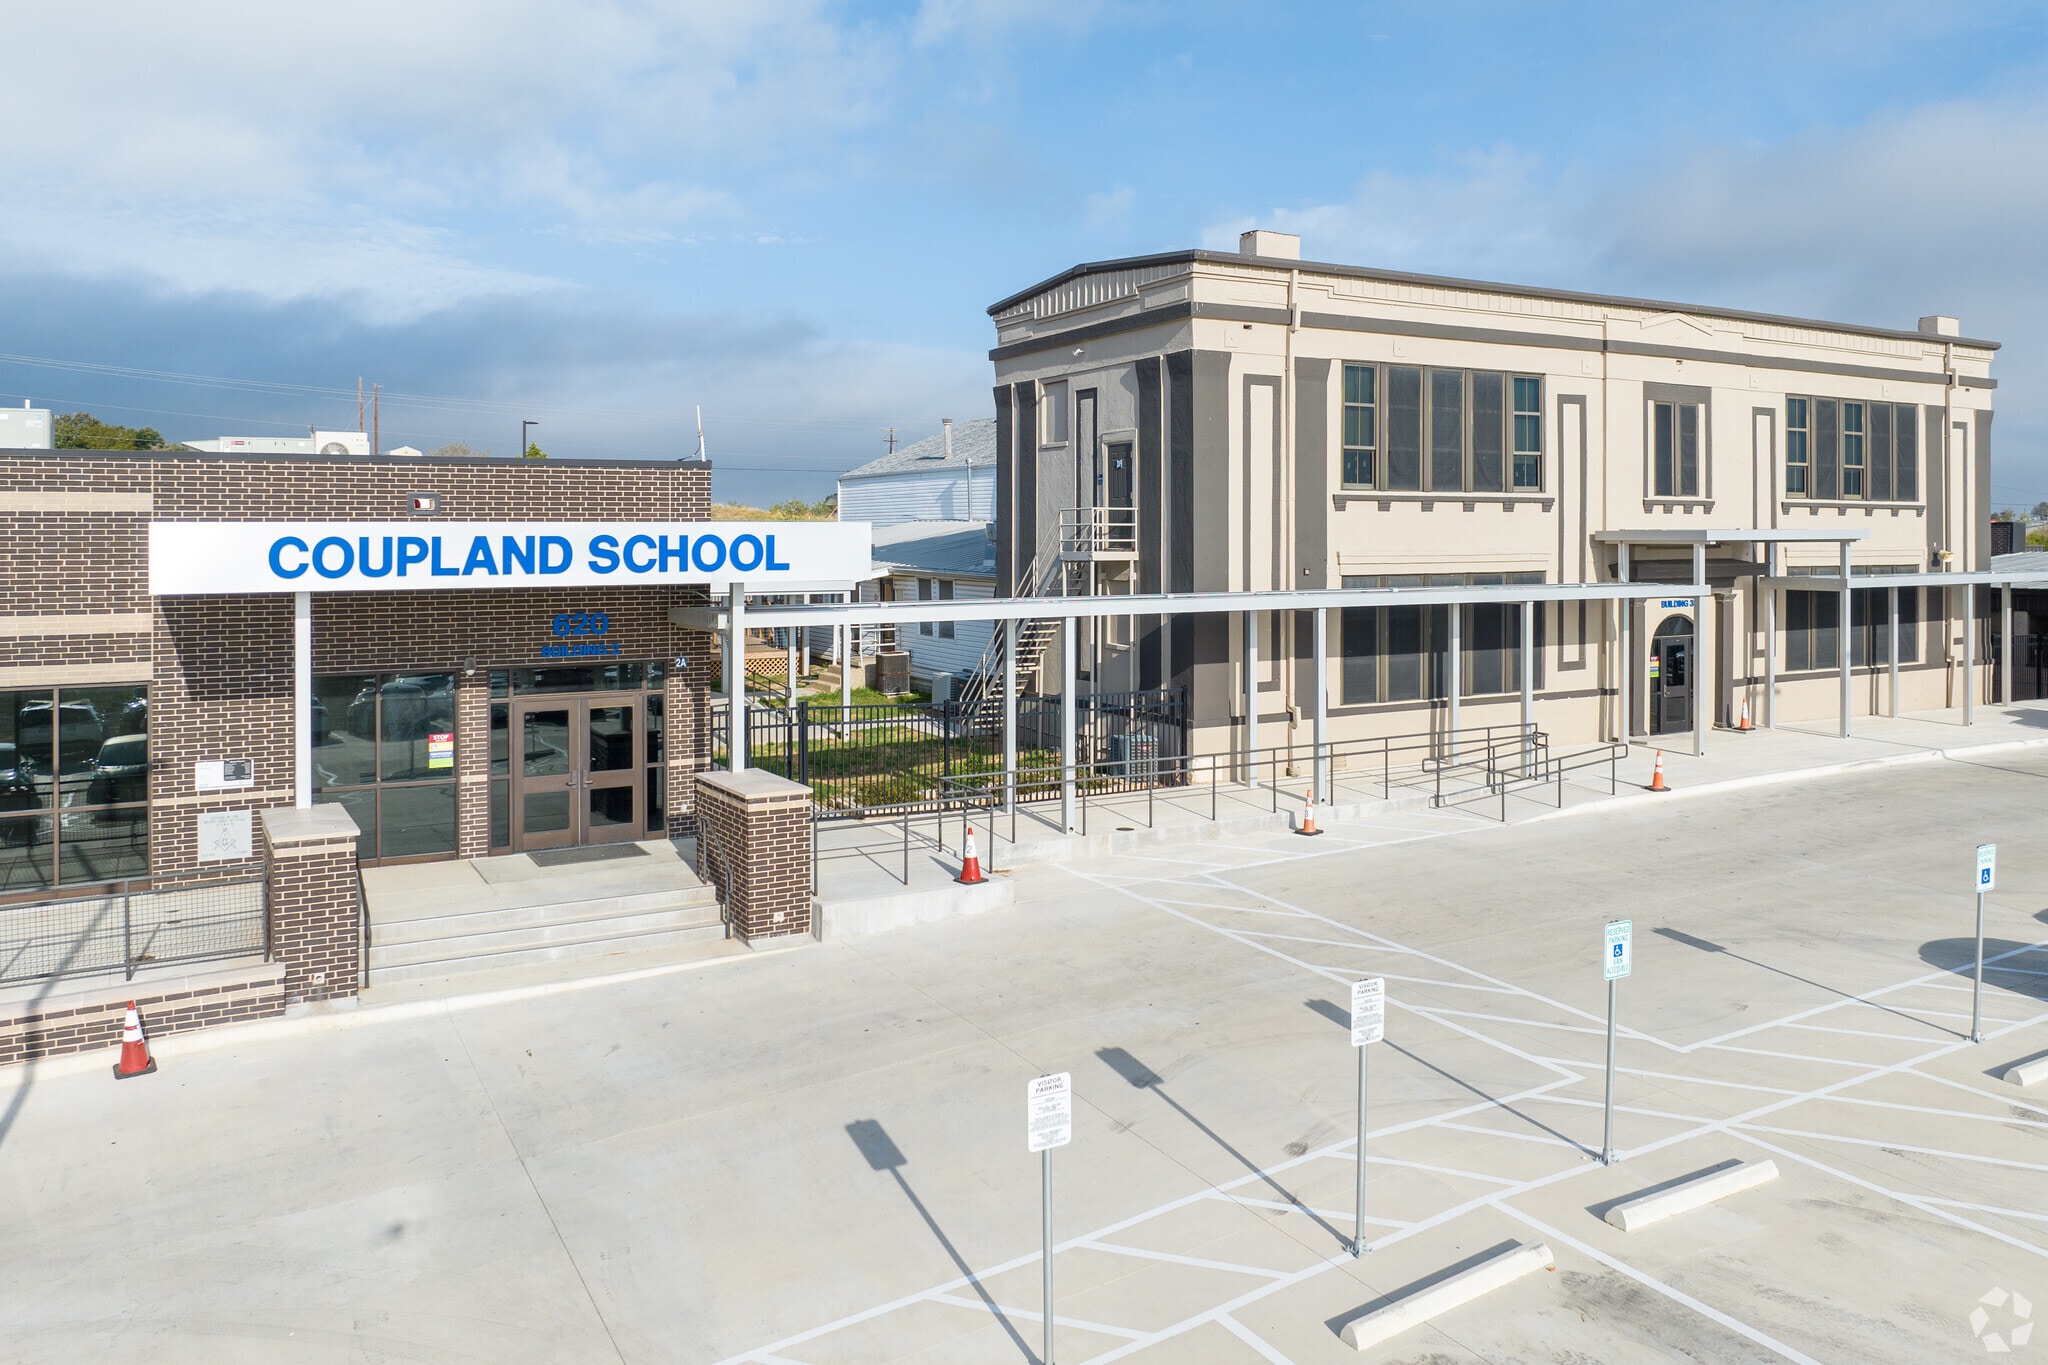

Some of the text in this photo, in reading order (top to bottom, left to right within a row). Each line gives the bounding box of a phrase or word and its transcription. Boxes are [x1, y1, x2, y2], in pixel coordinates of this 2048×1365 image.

[268, 533, 790, 579] COUPLAND SCHOOL
[1661, 600, 1689, 609] BUILDING
[552, 612, 609, 637] 620
[541, 643, 621, 658] BUILDING 2
[675, 657, 687, 668] 2A
[966, 845, 973, 854] 2
[1613, 957, 1623, 965] VAN
[1357, 986, 1380, 995] PARKING
[1358, 980, 1378, 990] VISITOR
[1037, 1076, 1062, 1087] VISITOR
[1035, 1082, 1064, 1094] PARKING
